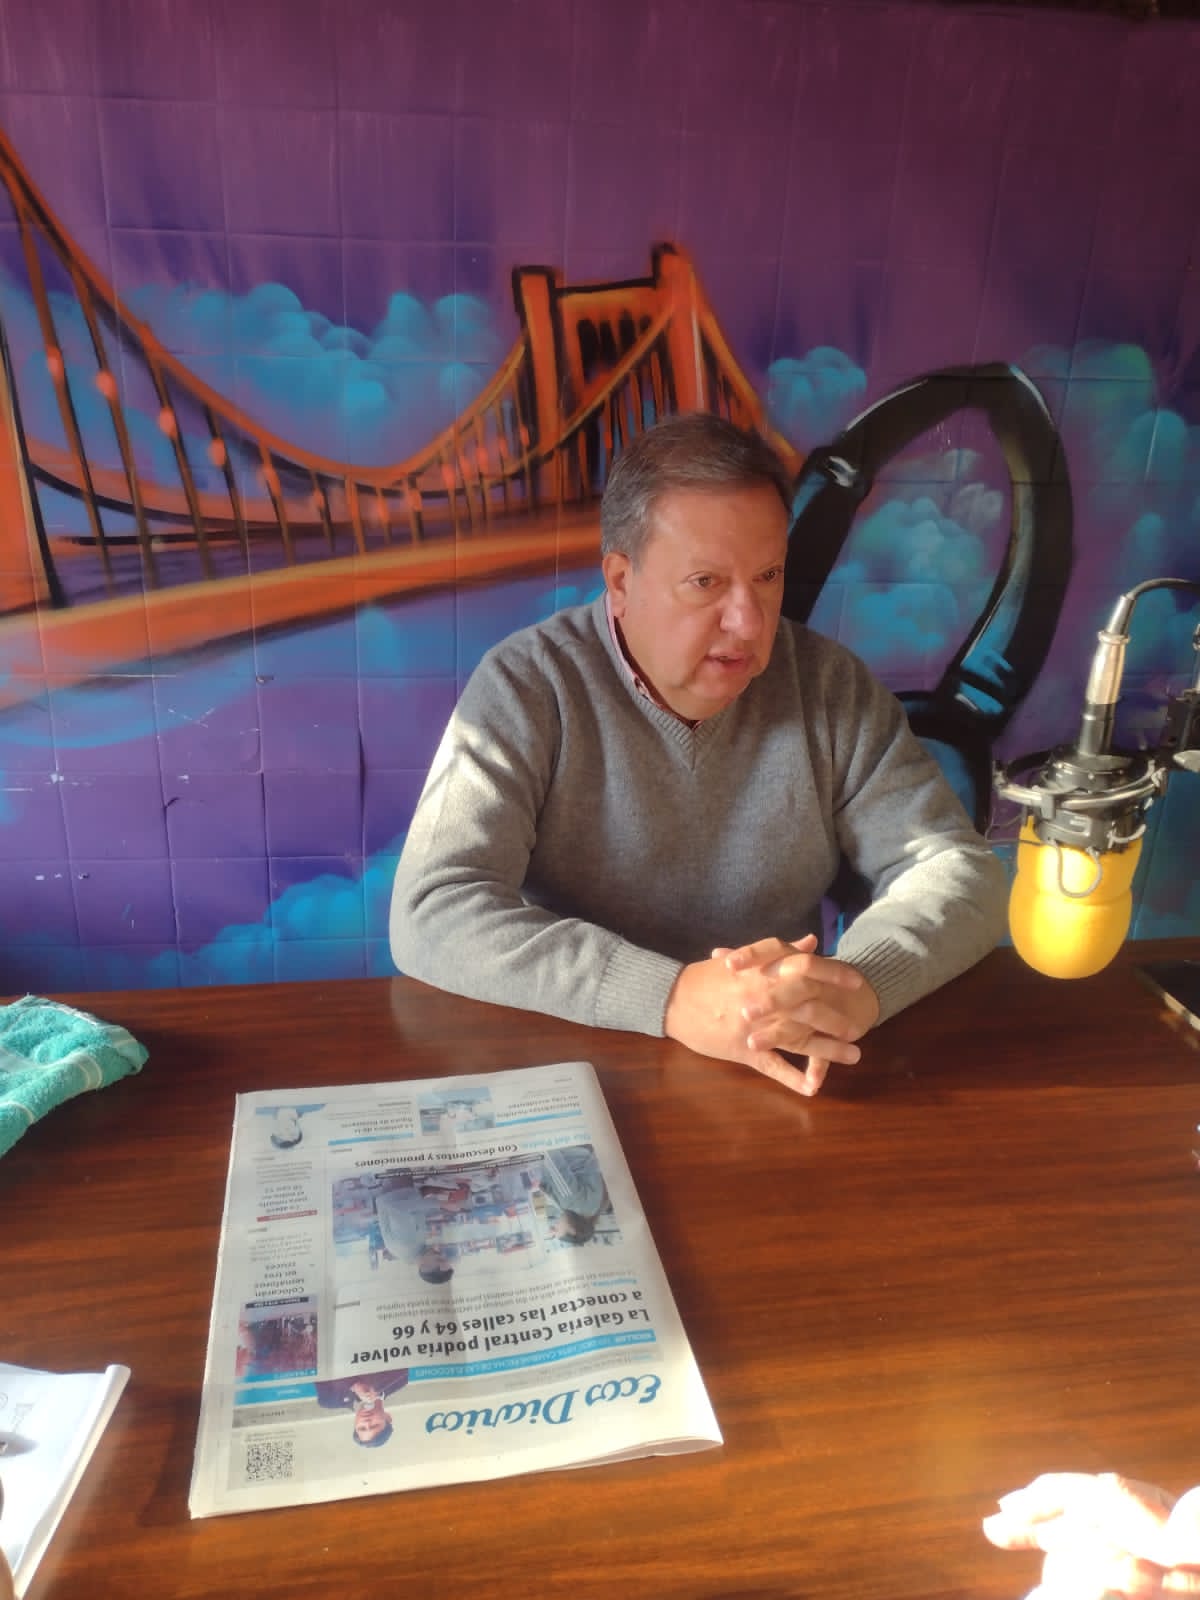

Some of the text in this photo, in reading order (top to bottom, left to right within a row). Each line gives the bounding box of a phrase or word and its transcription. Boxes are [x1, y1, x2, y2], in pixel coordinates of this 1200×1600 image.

[435, 1148, 495, 1162] descuentos
[498, 1144, 518, 1153] Con
[355, 1152, 425, 1169] promociones
[392, 1290, 642, 1340] a conectar las calles 64 y 66
[557, 1312, 624, 1335] Galería
[628, 1309, 650, 1322] La
[417, 1336, 478, 1357] podría
[484, 1327, 553, 1351] Central
[350, 1345, 411, 1364] volver
[425, 1374, 661, 1435] Ecos Diarios
